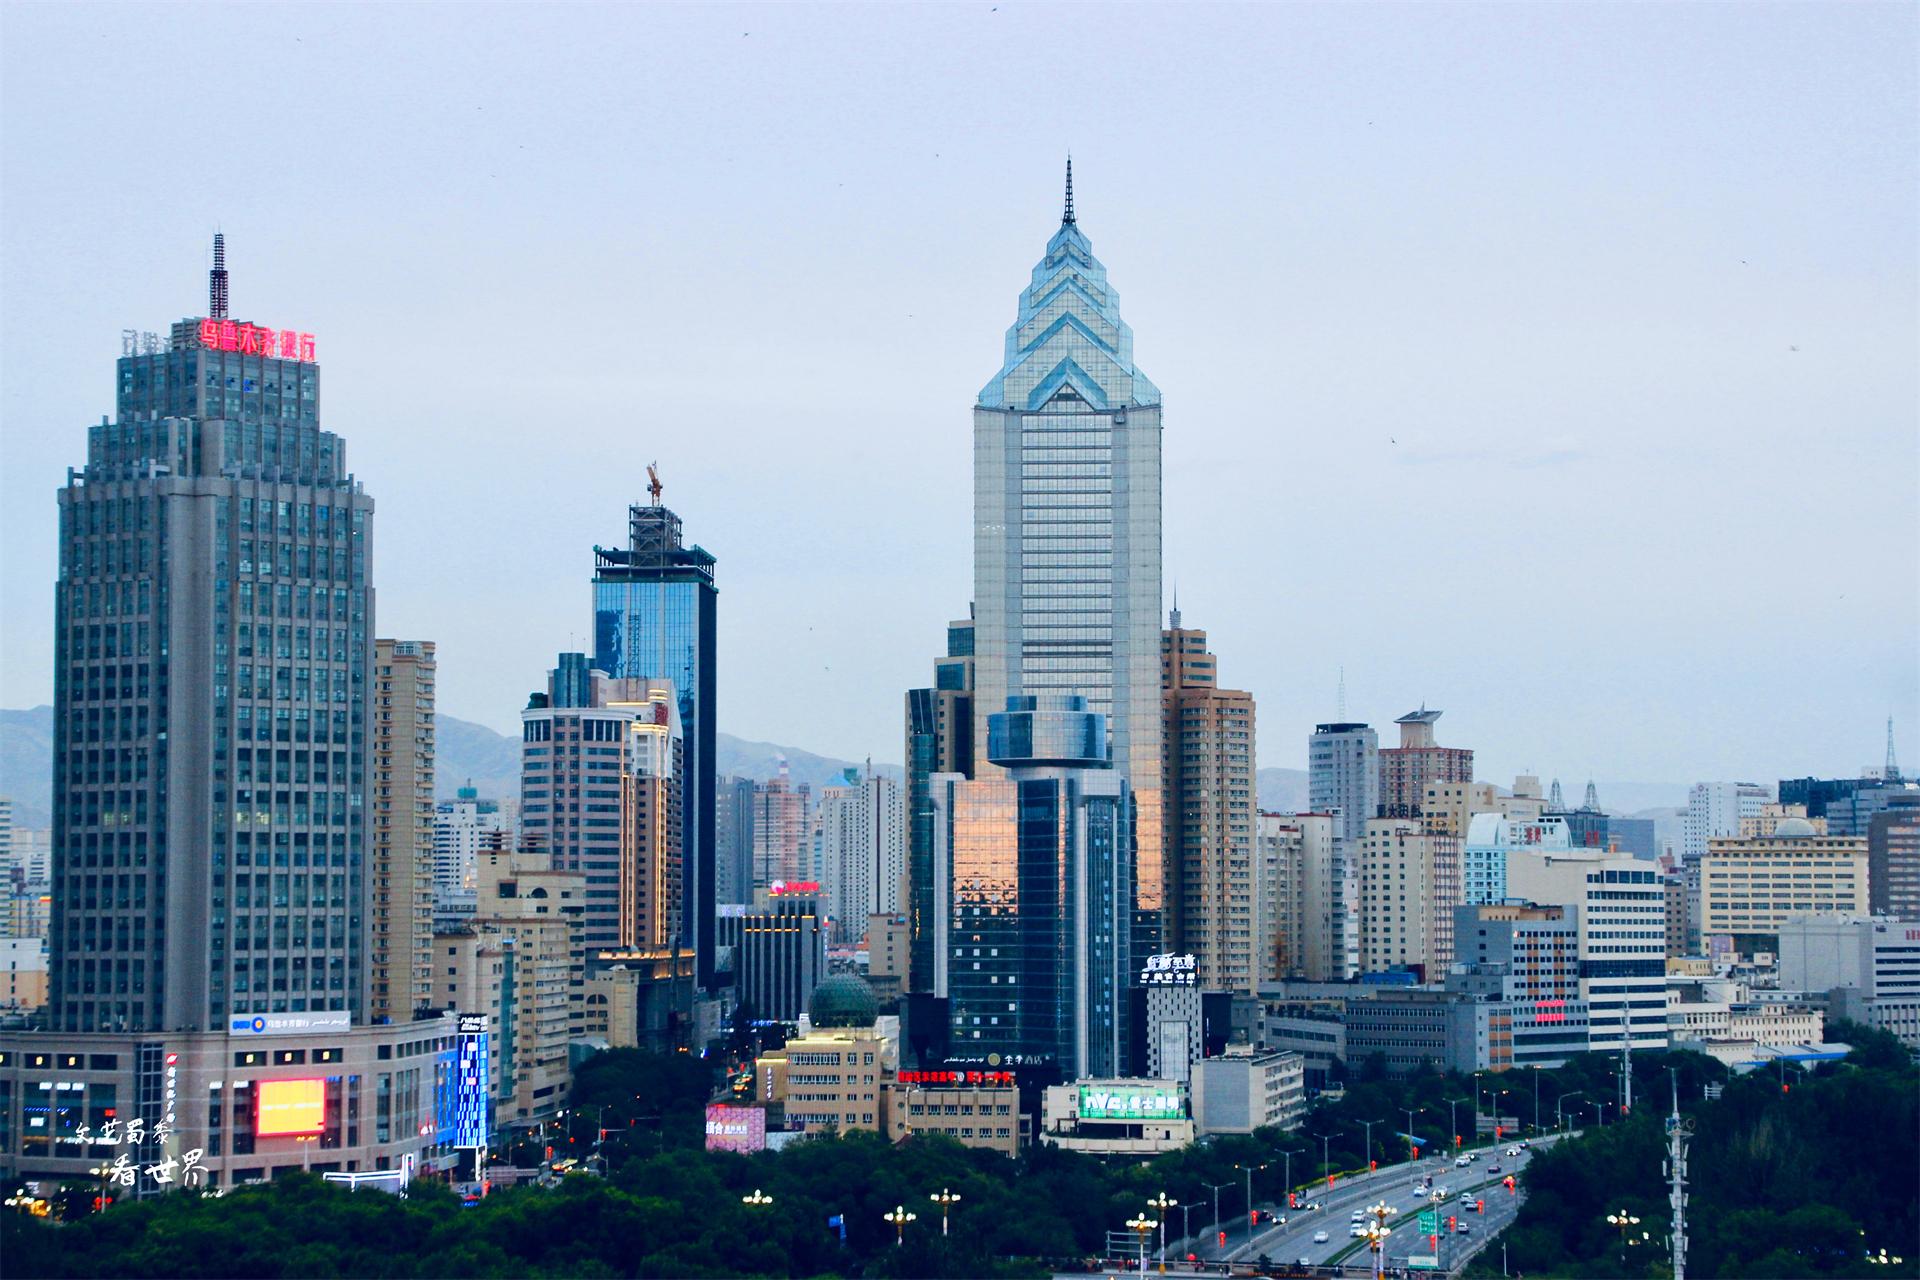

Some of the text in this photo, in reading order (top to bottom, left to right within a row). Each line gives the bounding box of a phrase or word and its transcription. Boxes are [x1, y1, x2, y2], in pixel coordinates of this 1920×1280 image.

[200, 317, 316, 362] 乌鲁木齐银行
